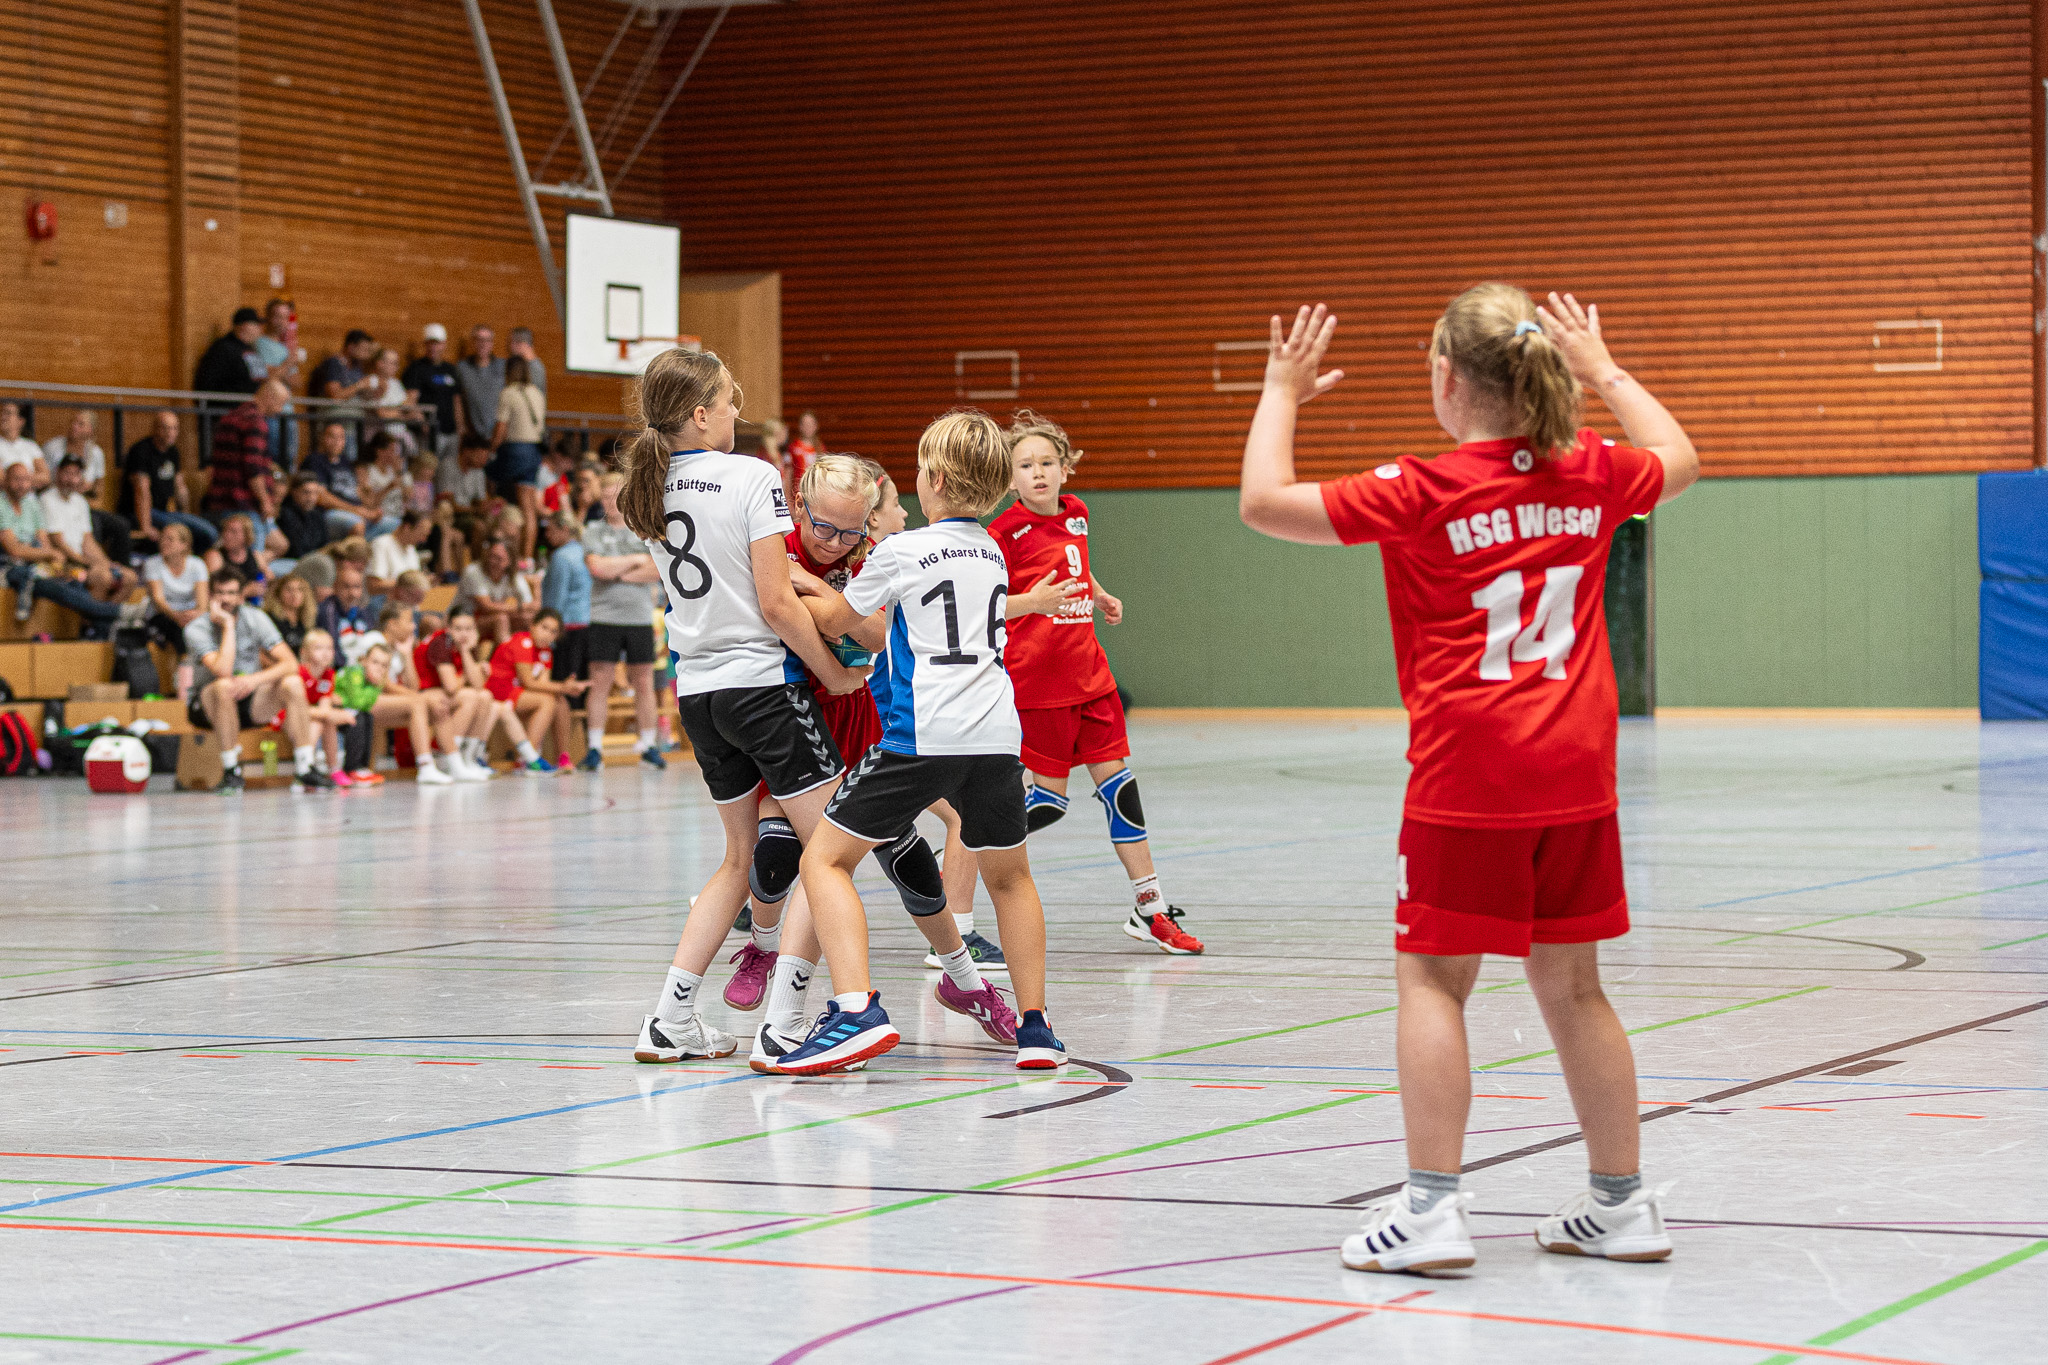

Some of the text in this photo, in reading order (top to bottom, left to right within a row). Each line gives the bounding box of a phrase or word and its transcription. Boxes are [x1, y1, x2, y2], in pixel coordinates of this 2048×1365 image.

[677, 479, 721, 493] Büttgen
[660, 510, 713, 600] 8
[1446, 502, 1602, 556] HSG Wesel
[918, 548, 1006, 571] HG Kaarst Büttg
[1064, 544, 1082, 577] 9
[921, 580, 1008, 669] 16
[1471, 565, 1584, 681] 14
